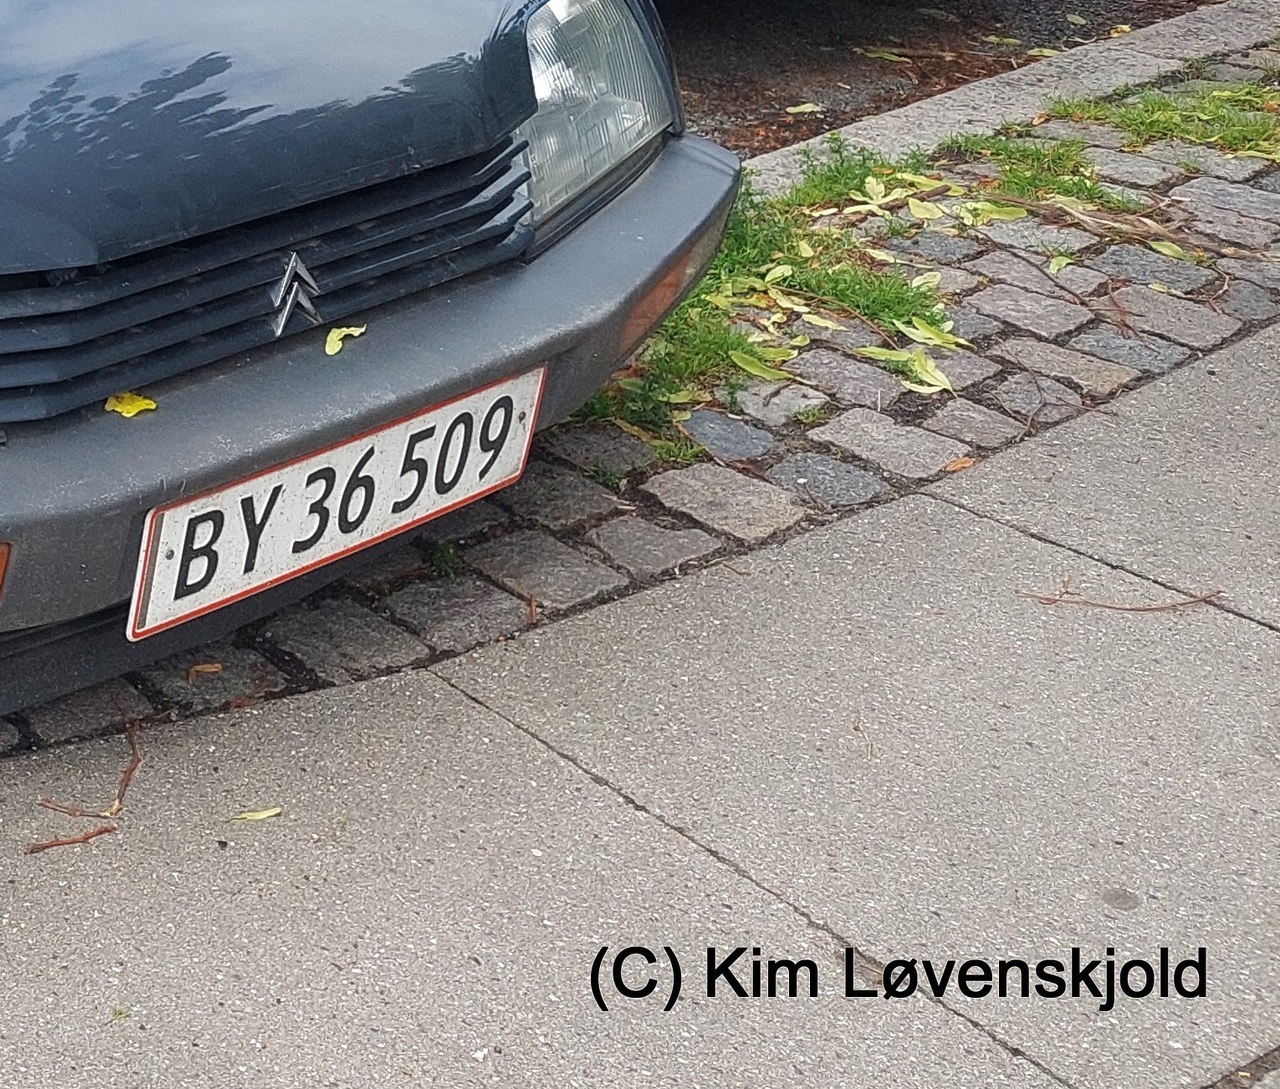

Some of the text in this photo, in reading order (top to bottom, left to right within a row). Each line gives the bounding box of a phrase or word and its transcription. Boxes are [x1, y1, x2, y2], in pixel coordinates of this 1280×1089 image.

[173, 395, 513, 600] BY 36 509
